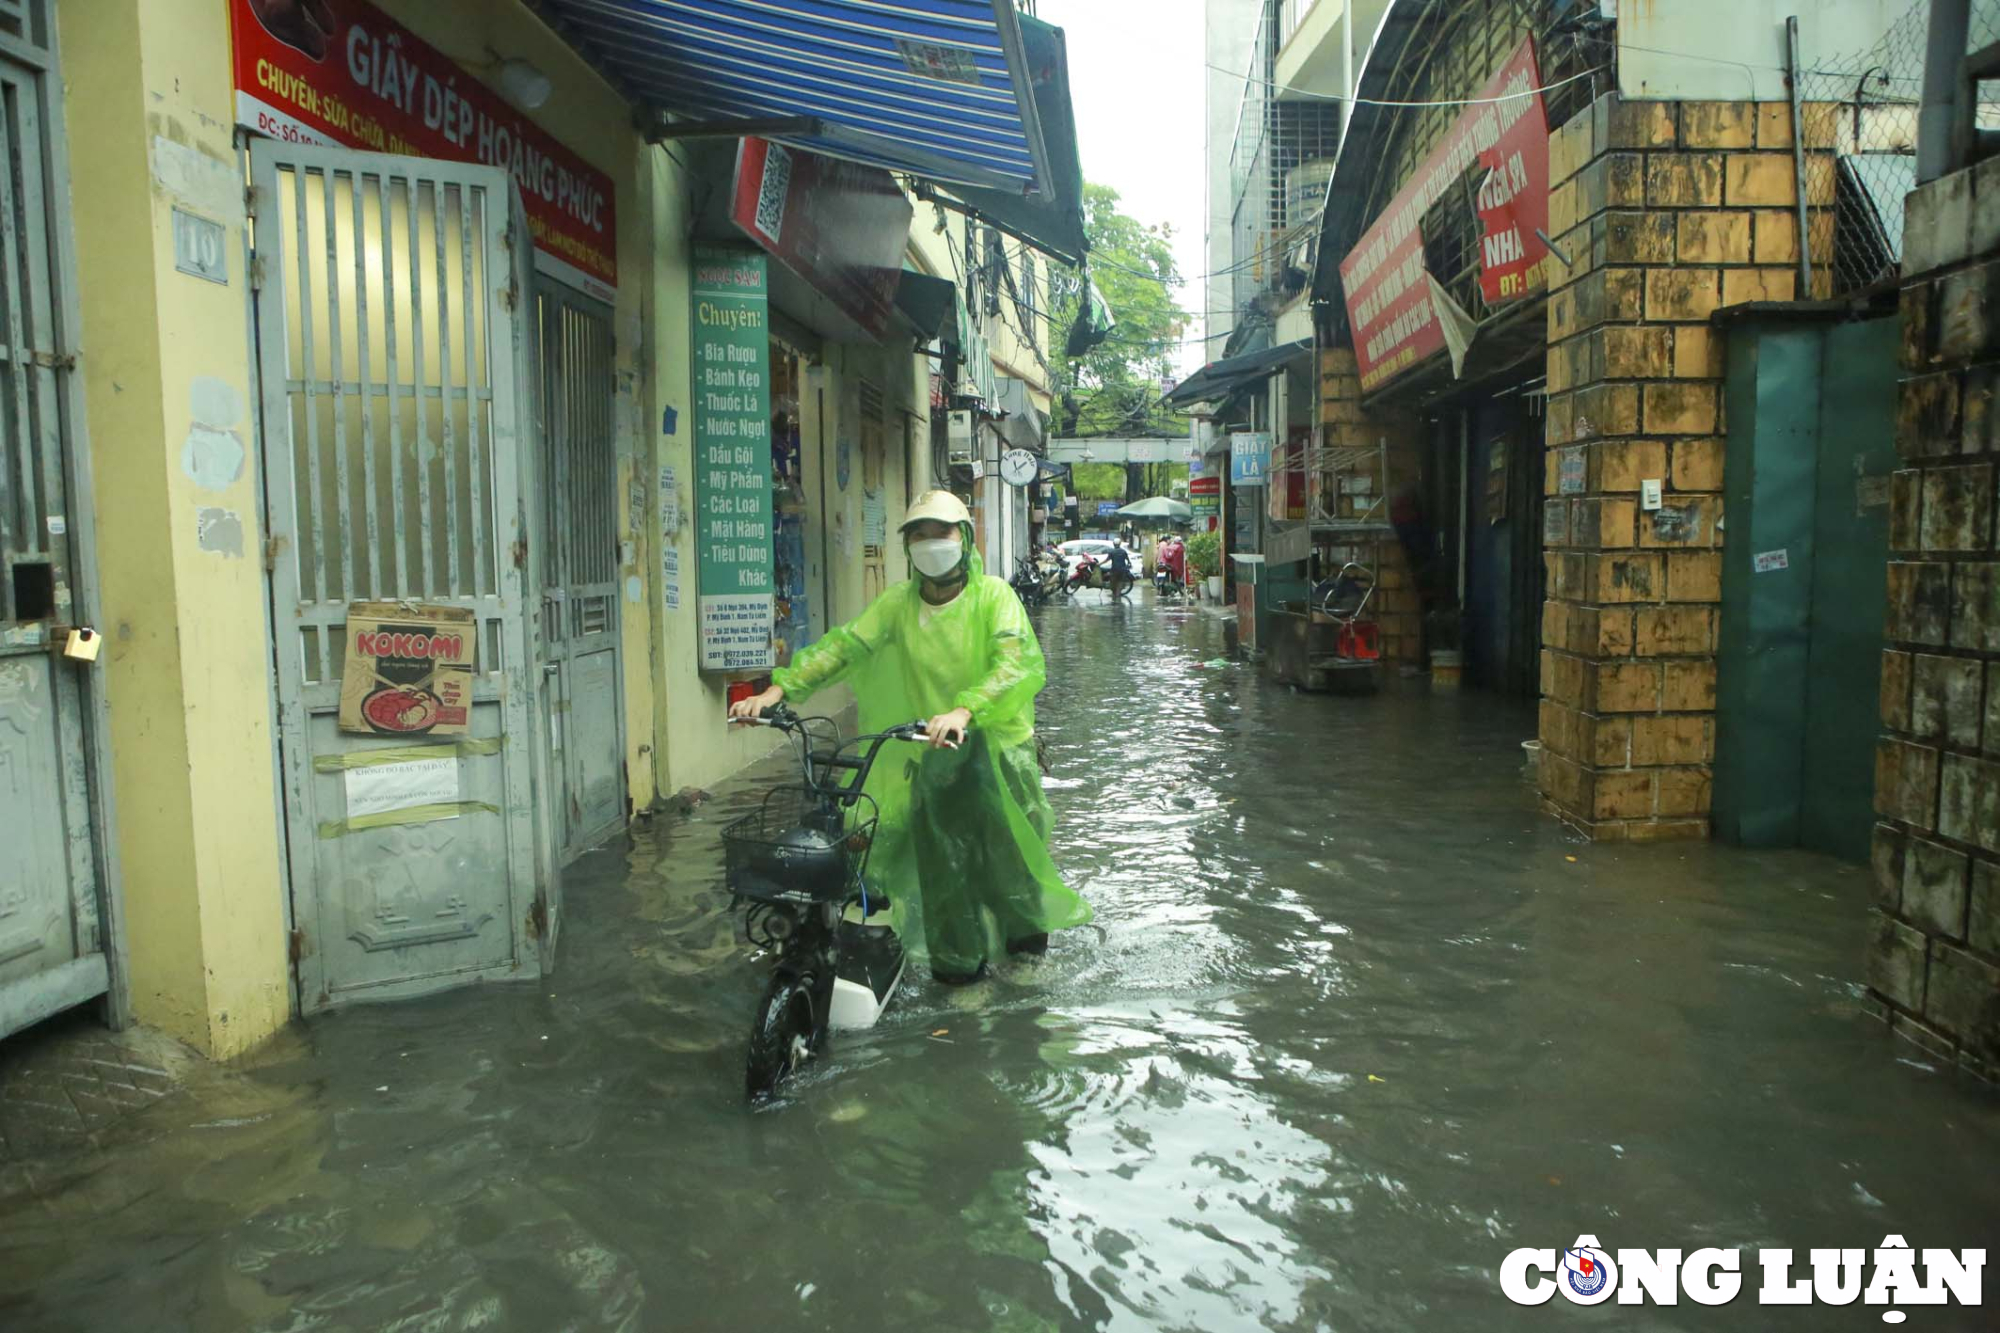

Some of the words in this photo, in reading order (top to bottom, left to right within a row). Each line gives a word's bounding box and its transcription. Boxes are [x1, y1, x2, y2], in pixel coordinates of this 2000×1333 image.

[255, 58, 322, 118] CHUYÊN:
[323, 93, 350, 132] SỬA
[1471, 105, 1500, 154] THÔNG
[1495, 67, 1534, 135] THƯỜNG
[257, 111, 281, 137] ĐC:
[282, 124, 299, 143] SỐ
[423, 75, 475, 149] DÉP
[477, 111, 554, 202] HOÀNG
[556, 166, 603, 233] PHÚC
[188, 224, 217, 266] 10
[1483, 219, 1525, 270] NHÀ
[699, 302, 761, 331] Chuyên:
[705, 343, 724, 361] Bia
[727, 344, 757, 366] Rượu
[705, 368, 735, 386] Bánh
[738, 369, 760, 391] Kẹo
[706, 391, 741, 411] Thuốc
[744, 394, 758, 412] Lá
[707, 417, 737, 436] Nước
[739, 418, 766, 441] Ngọt
[734, 446, 754, 469] Gội
[1002, 450, 1021, 462] Long
[1022, 452, 1036, 467] Hair
[709, 470, 728, 491] Mỹ
[730, 467, 763, 489] Phẩm
[710, 494, 732, 513] Các
[736, 496, 760, 517] Loại
[711, 519, 734, 542] Mặt
[736, 519, 765, 540] Hàng
[711, 544, 736, 563] Tiêu
[738, 544, 767, 564] Dùng
[738, 568, 767, 587] Khác
[356, 630, 462, 660] KOKOMI
